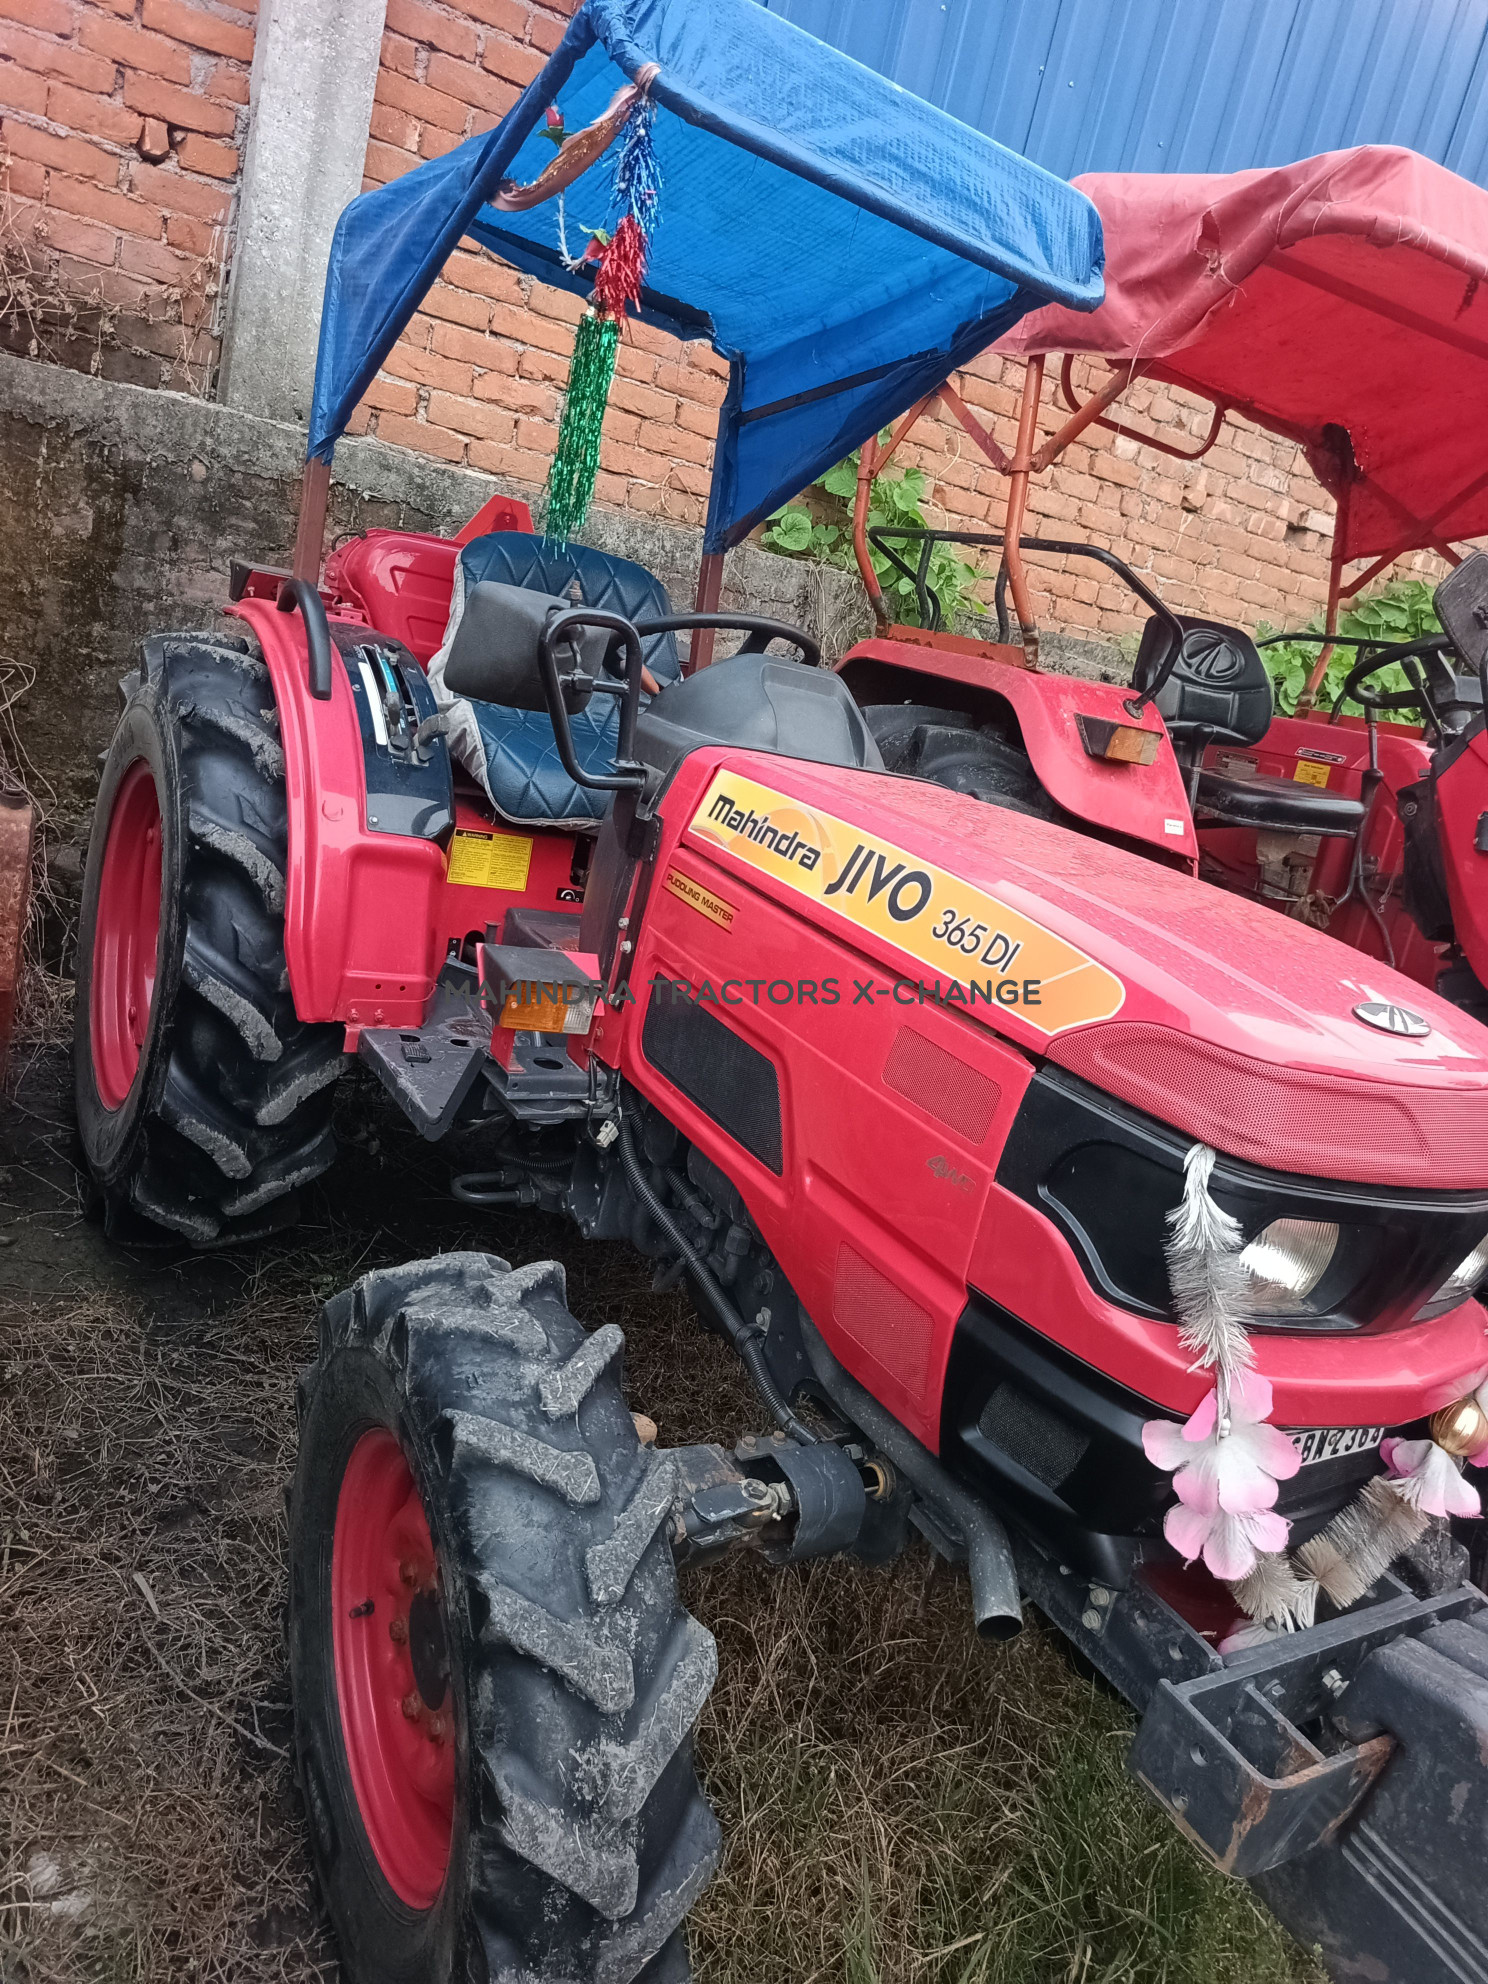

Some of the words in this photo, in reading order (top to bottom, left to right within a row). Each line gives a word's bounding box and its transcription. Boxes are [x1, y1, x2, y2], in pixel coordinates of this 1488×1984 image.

[666, 873, 701, 902] PUDDLING
[700, 896, 734, 924] MASTER
[707, 794, 821, 871] Mahindra
[824, 845, 932, 921] JIVO
[932, 910, 984, 953] 365
[979, 933, 1022, 974] DI
